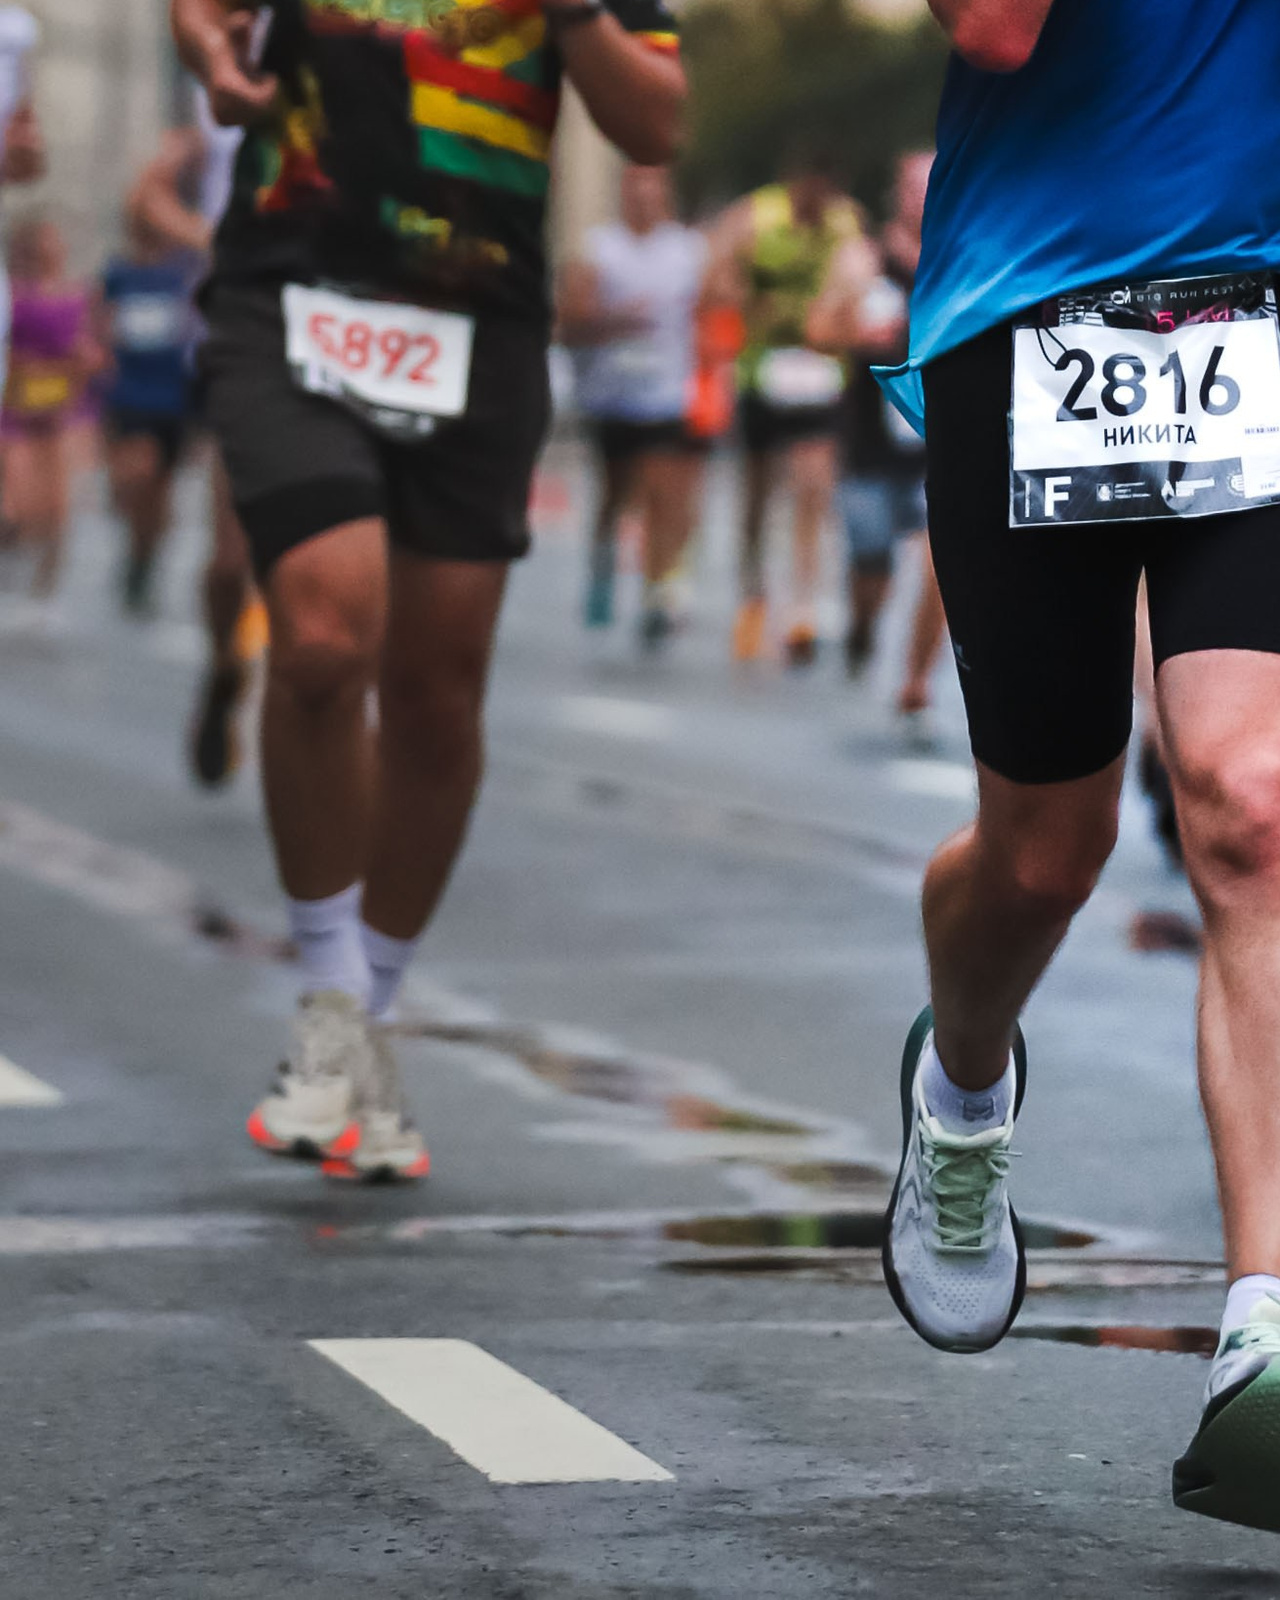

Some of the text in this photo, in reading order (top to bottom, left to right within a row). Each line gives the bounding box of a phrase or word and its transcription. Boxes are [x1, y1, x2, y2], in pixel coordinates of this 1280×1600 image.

[308, 312, 442, 386] 5892
[1055, 345, 1241, 422] 2816
[1103, 424, 1198, 448] НИКИТА
[1044, 475, 1073, 517] F
